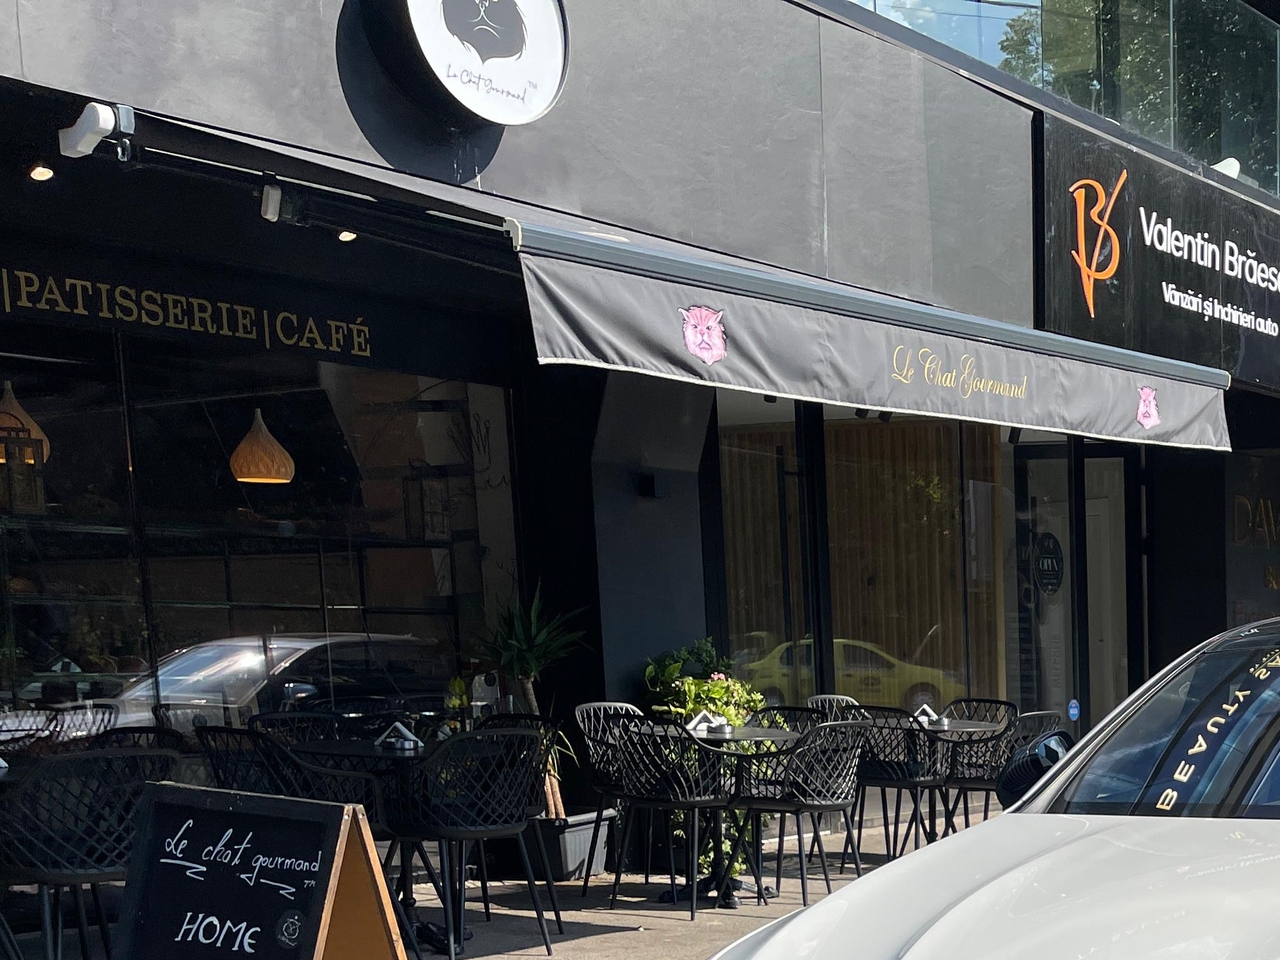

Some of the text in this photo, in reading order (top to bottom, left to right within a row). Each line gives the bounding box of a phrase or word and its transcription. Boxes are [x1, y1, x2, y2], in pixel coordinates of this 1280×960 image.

[1139, 206, 1220, 272] Valentin
[1161, 281, 1202, 314] Vânzări
[1255, 316, 1279, 337] auto
[275, 317, 371, 357] CAFÉ
[891, 345, 1028, 399] Le Chat Gourmand
[164, 818, 322, 887] Le chat gourmand
[174, 911, 262, 954] HOME
